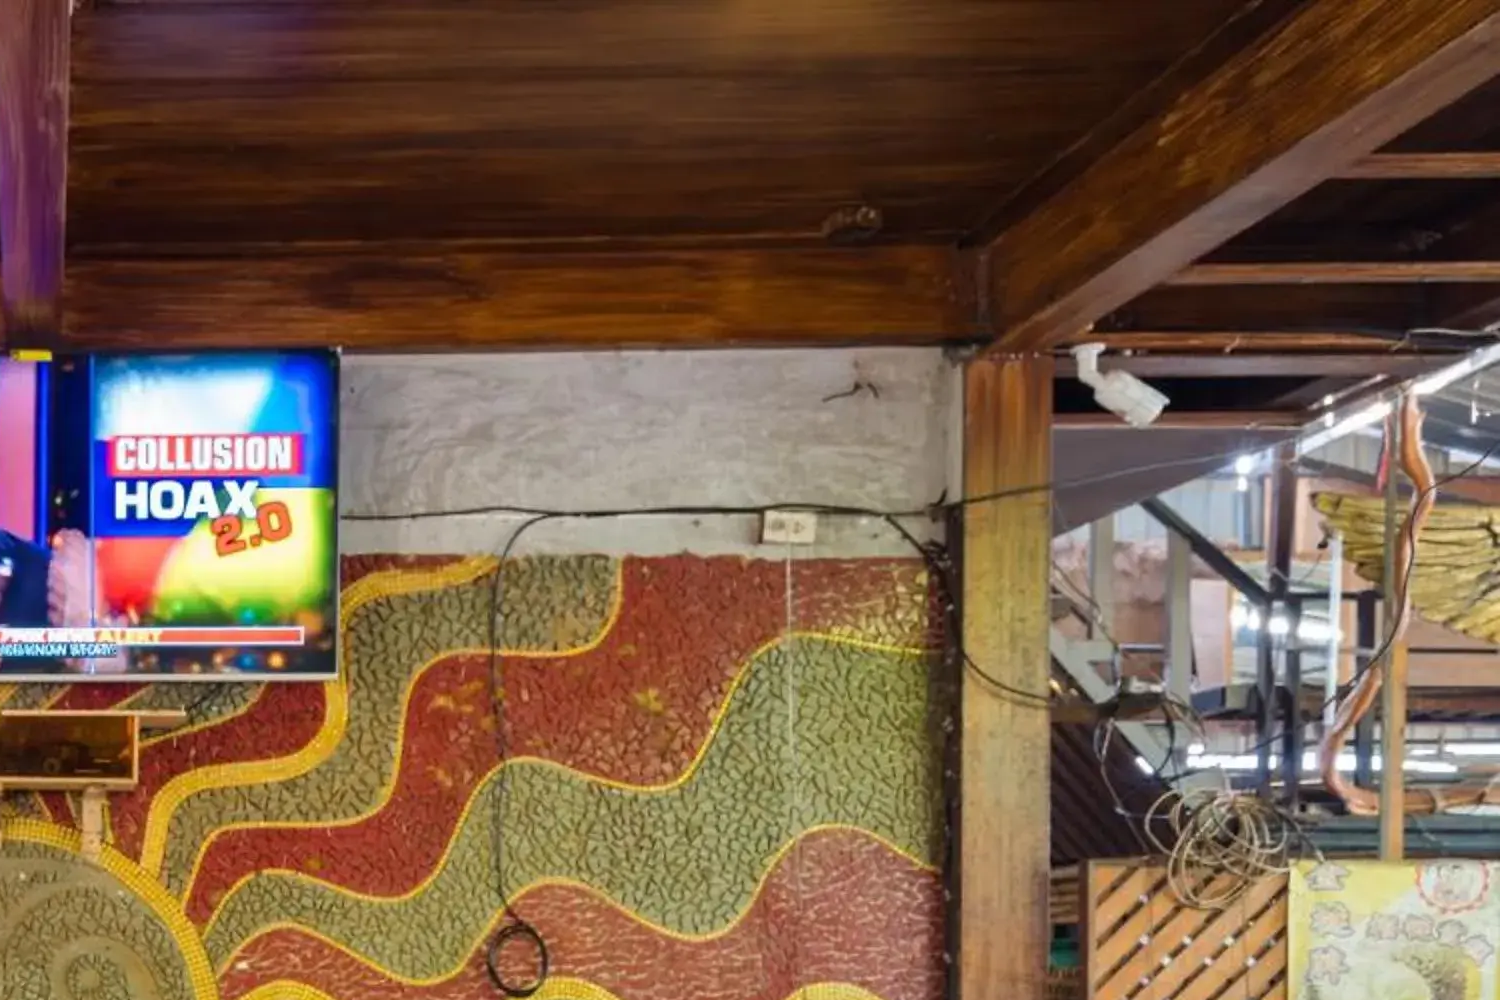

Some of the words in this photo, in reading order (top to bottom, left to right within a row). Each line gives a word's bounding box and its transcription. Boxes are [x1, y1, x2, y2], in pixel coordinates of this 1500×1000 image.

[116, 435, 293, 472] COLLUSION
[114, 480, 259, 521] HOAX
[210, 500, 293, 558] 2.0
